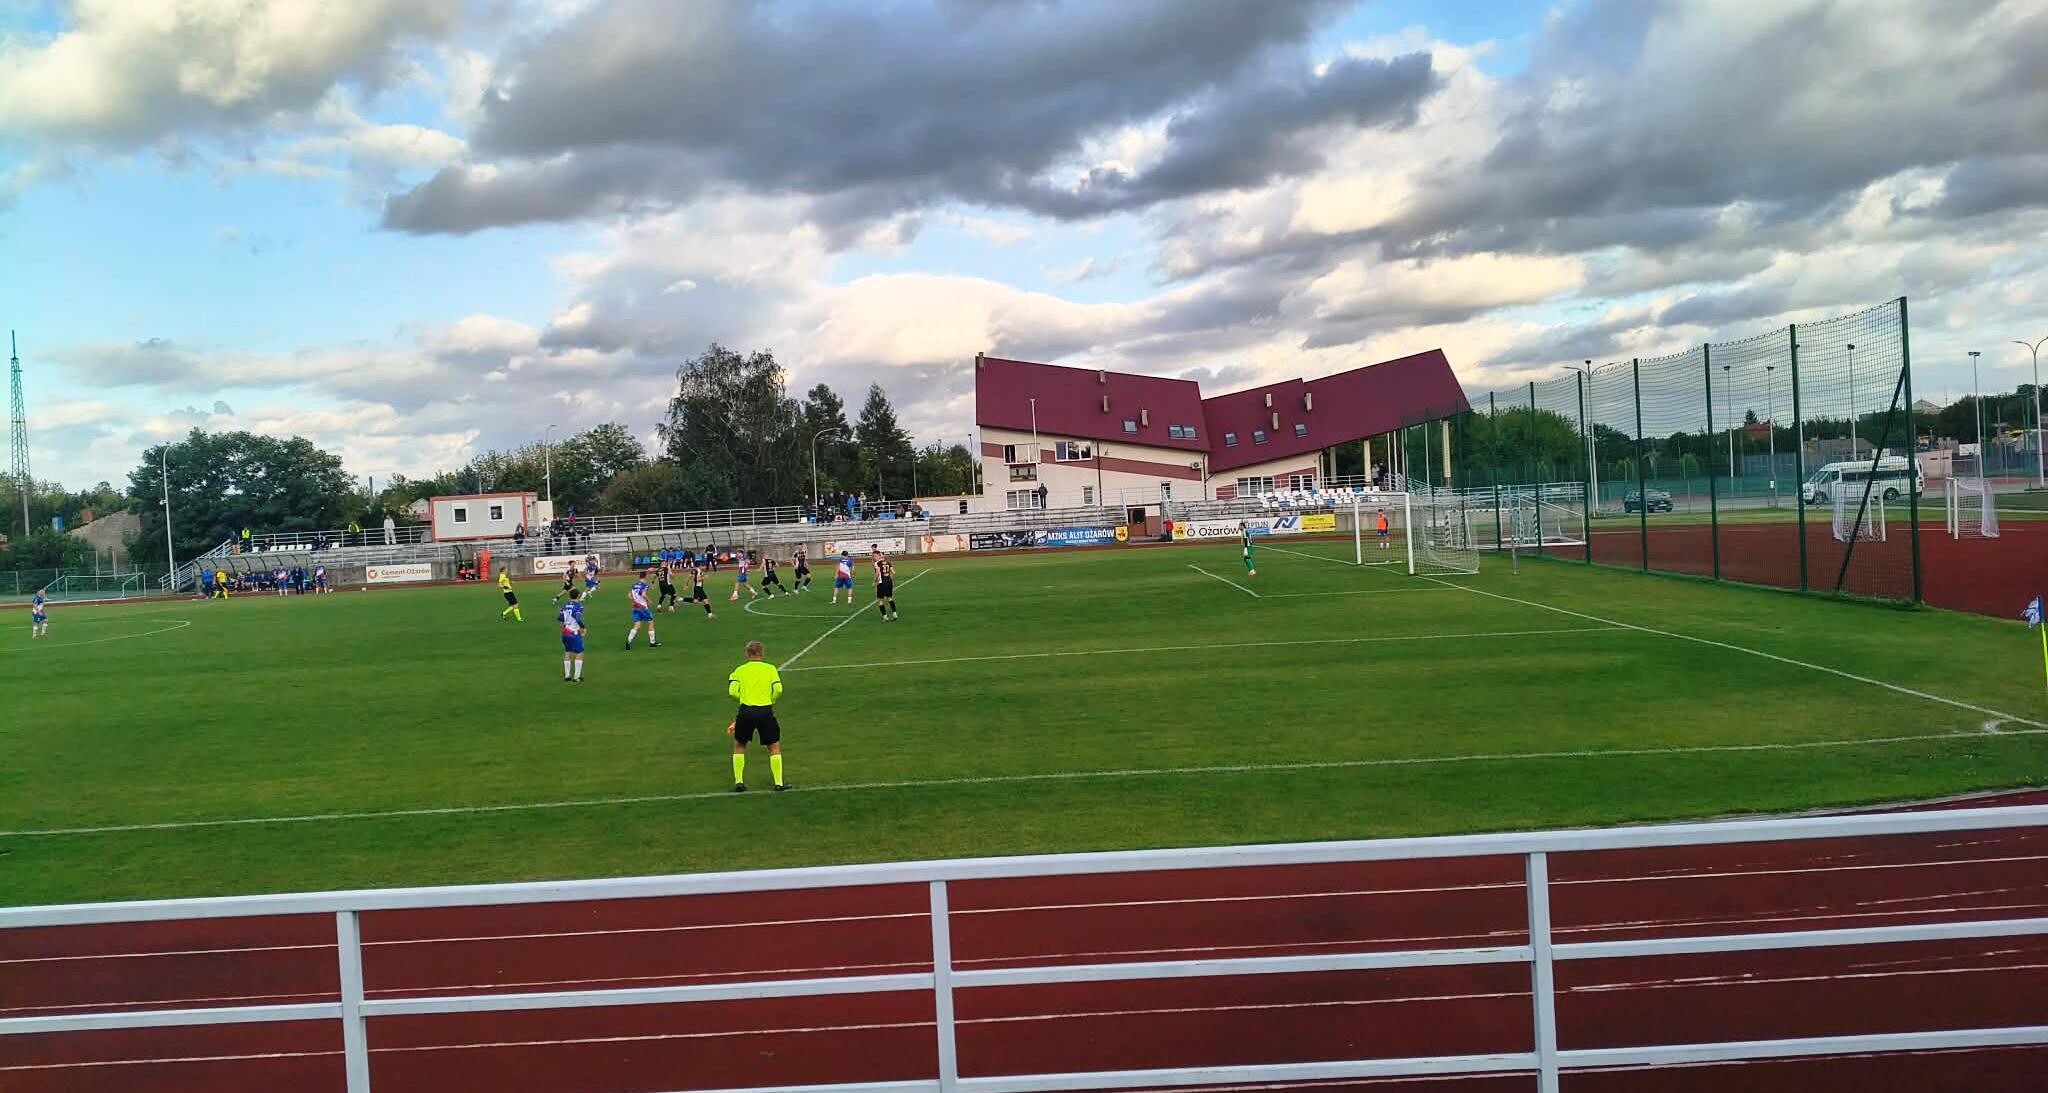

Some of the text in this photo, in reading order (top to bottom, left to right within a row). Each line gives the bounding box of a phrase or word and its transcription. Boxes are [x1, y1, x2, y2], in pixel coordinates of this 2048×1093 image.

[1047, 532, 1068, 541] MZKS
[1068, 531, 1084, 540] ALIT
[1085, 528, 1115, 539] OŻARÓW
[1199, 525, 1240, 537] Ożarów
